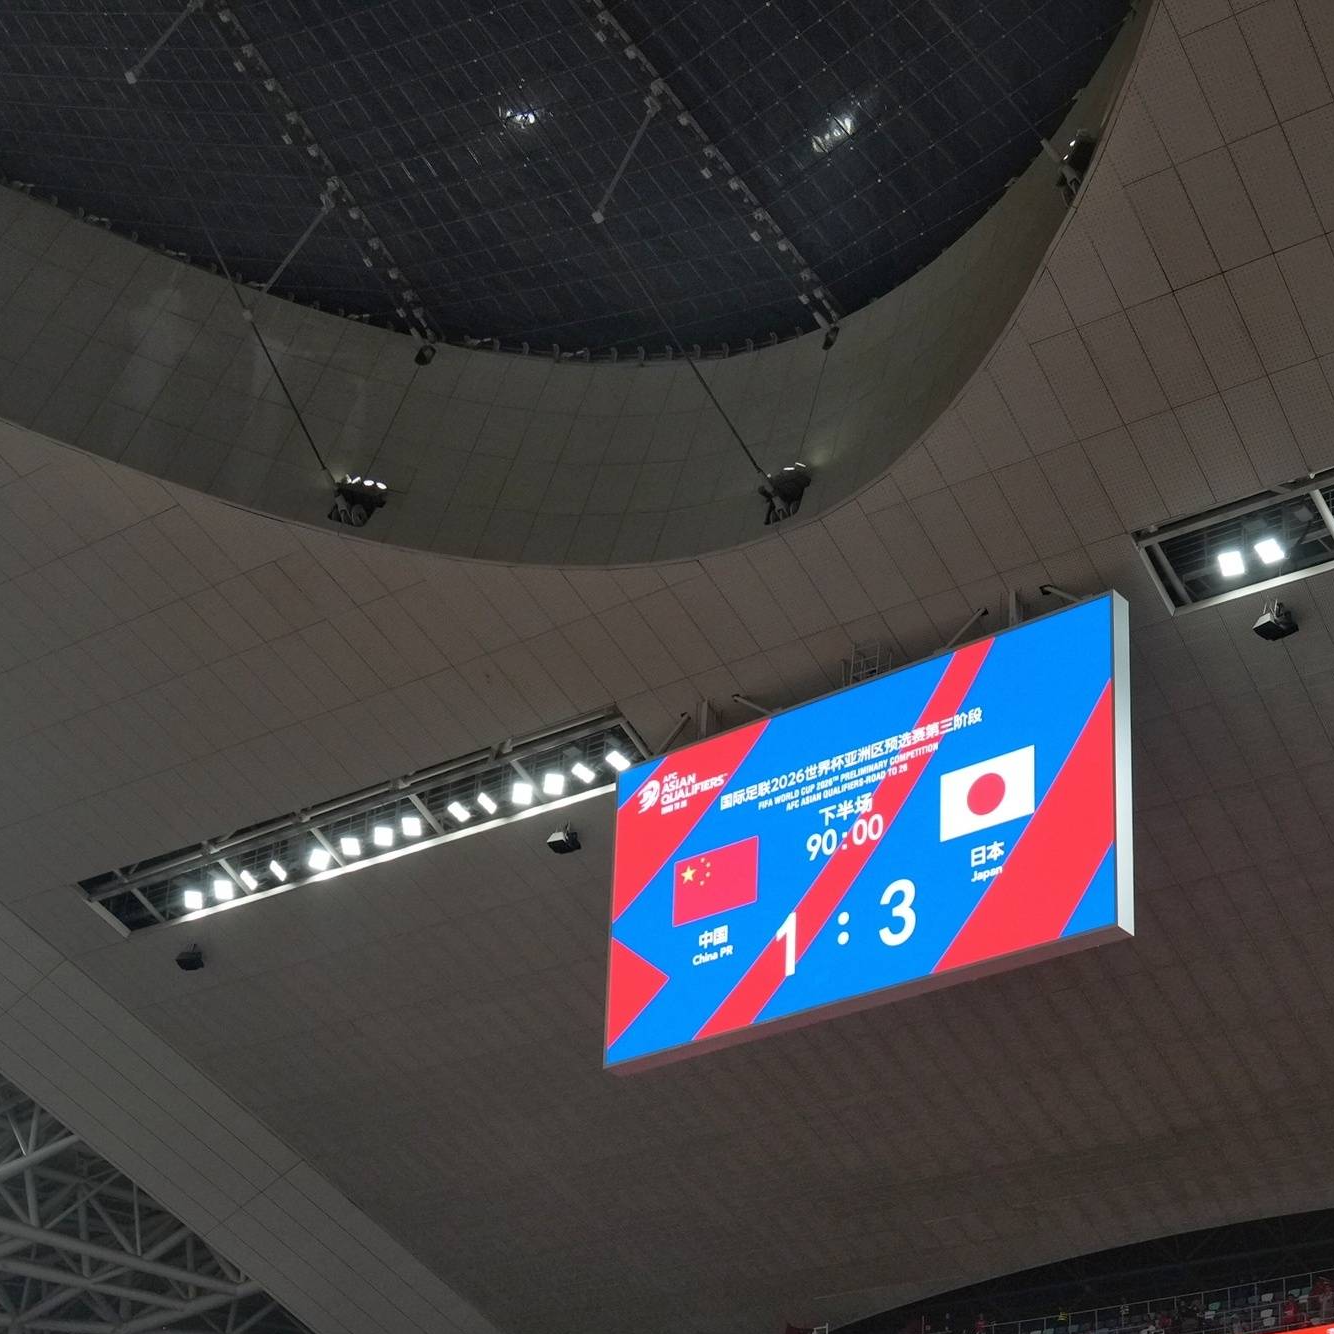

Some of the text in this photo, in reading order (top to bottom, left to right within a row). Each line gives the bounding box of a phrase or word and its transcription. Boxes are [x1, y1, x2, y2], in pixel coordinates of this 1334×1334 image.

[720, 706, 983, 811] 国际足联2026世界杯亚洲区预选赛第三阶段
[661, 773, 696, 795] ASIAN
[758, 798, 773, 811] FIFA
[774, 790, 800, 807] WORLD
[800, 784, 816, 799] CUP
[840, 757, 888, 783] PRELIMINARY
[889, 742, 939, 767] COMPETITION
[785, 801, 800, 812] AFC
[800, 794, 822, 807] ASIAN
[818, 791, 873, 826] 下半场
[806, 813, 884, 861] 90:00
[970, 841, 1005, 867] 日本
[970, 864, 1003, 883] Japan
[698, 924, 729, 949] 中国
[776, 911, 797, 977] 1
[878, 878, 916, 947] 3
[692, 945, 734, 966] China PR
